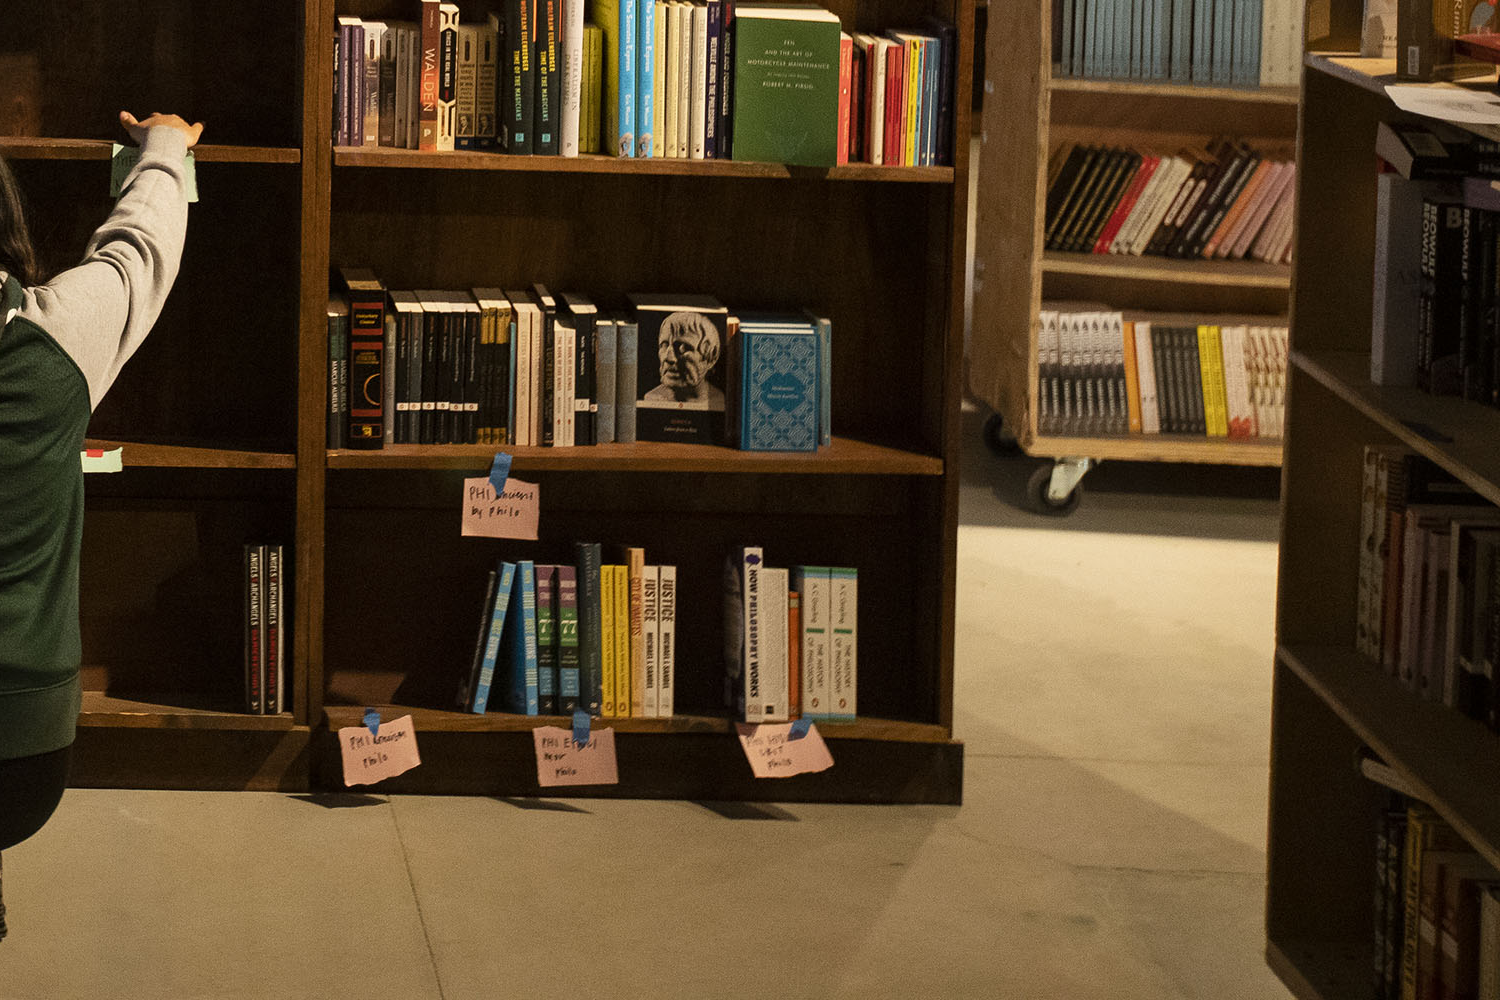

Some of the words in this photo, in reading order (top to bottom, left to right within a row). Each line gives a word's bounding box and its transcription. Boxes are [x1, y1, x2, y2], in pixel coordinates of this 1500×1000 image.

[514, 67, 520, 75] OF
[623, 45, 631, 71] Express
[644, 46, 652, 72] Express
[748, 59, 786, 67] MOTORCYCLE
[788, 61, 829, 69] MAINTENANCE
[423, 48, 436, 113] WALDEN
[541, 67, 547, 76] OF
[514, 87, 522, 121] MAGICIANS
[572, 101, 577, 111] IN
[1428, 205, 1437, 278] BEOWULF
[1461, 208, 1470, 281] BEOWULF
[269, 583, 277, 625] ARCHANGELS
[644, 579, 656, 622] JUSTICE
[662, 579, 673, 623] JUSTICE
[561, 619, 578, 634] 77
[750, 595, 758, 658] PHILOSOPHY
[807, 637, 814, 648] OF
[835, 638, 842, 649] OF
[662, 666, 670, 689] SANDEL
[750, 662, 758, 697] WORKS
